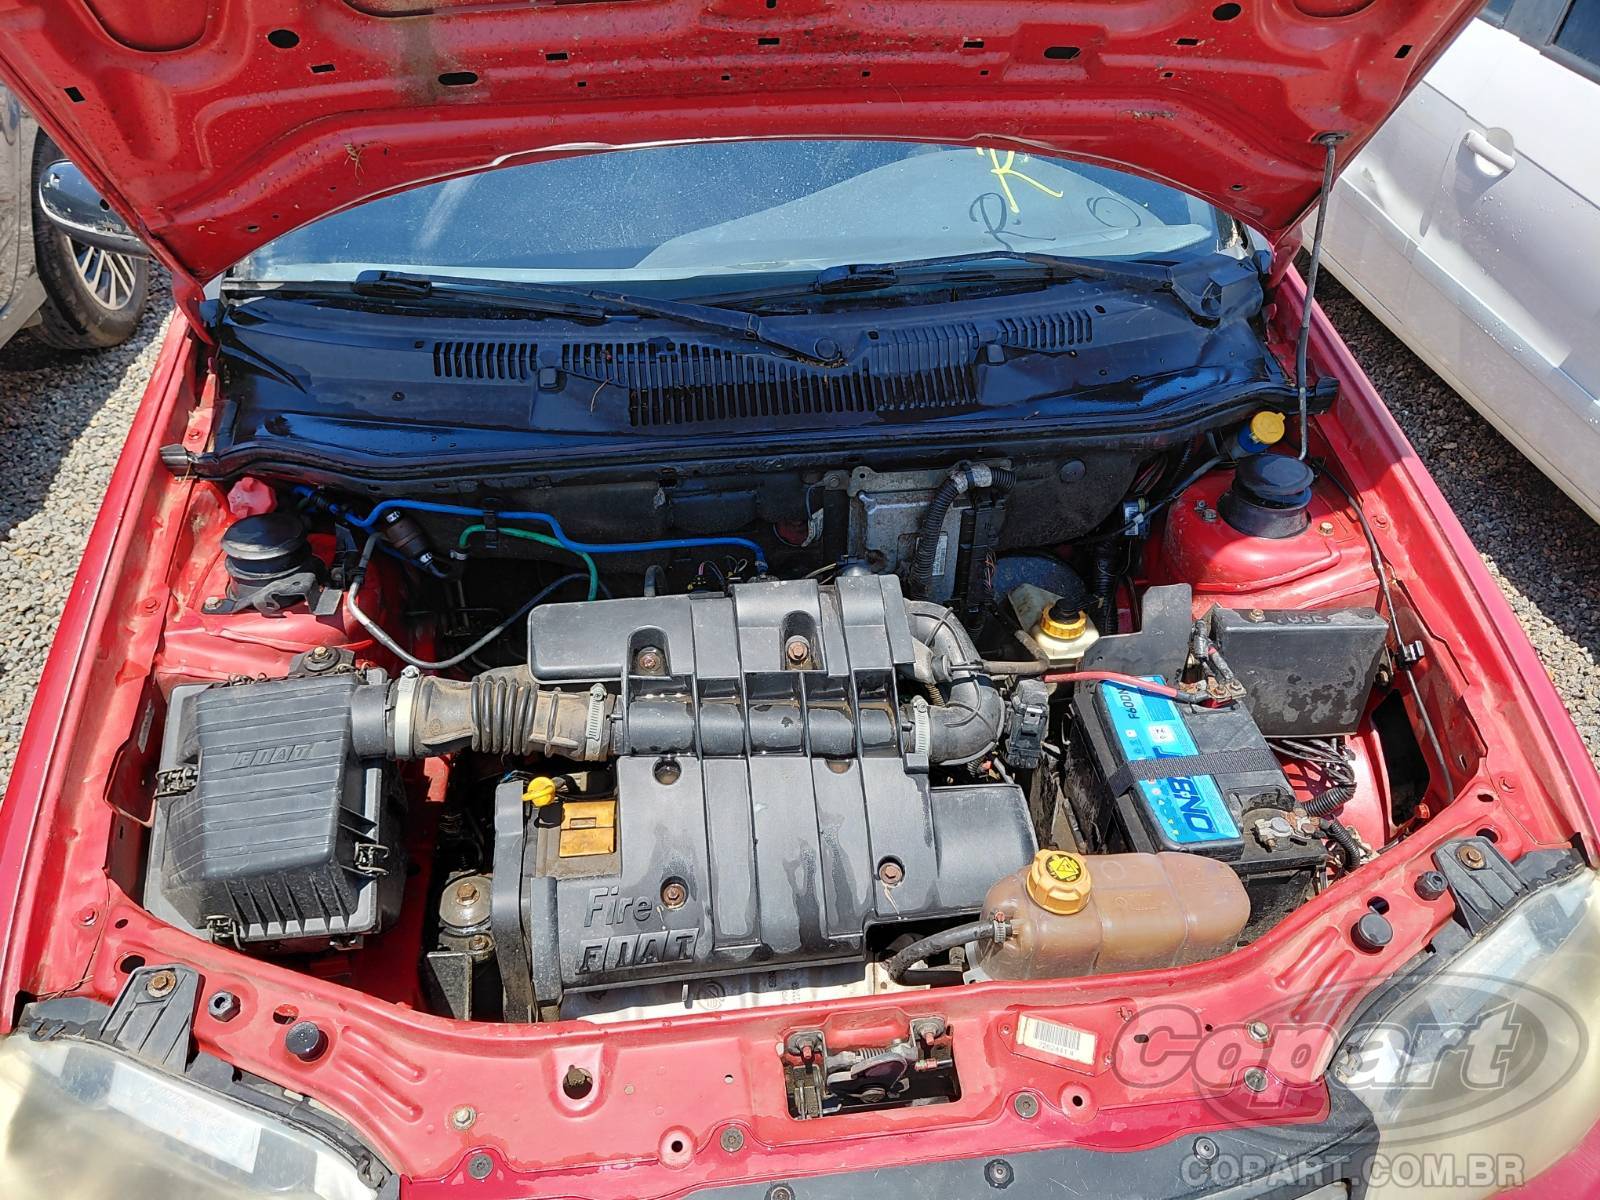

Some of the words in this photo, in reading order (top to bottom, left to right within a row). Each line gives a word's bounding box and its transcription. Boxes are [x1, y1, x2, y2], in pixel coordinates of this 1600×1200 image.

[231, 744, 314, 769] FIAT
[1150, 745, 1215, 833] ONBT
[583, 885, 653, 928] Fire
[574, 928, 700, 976] FIAT
